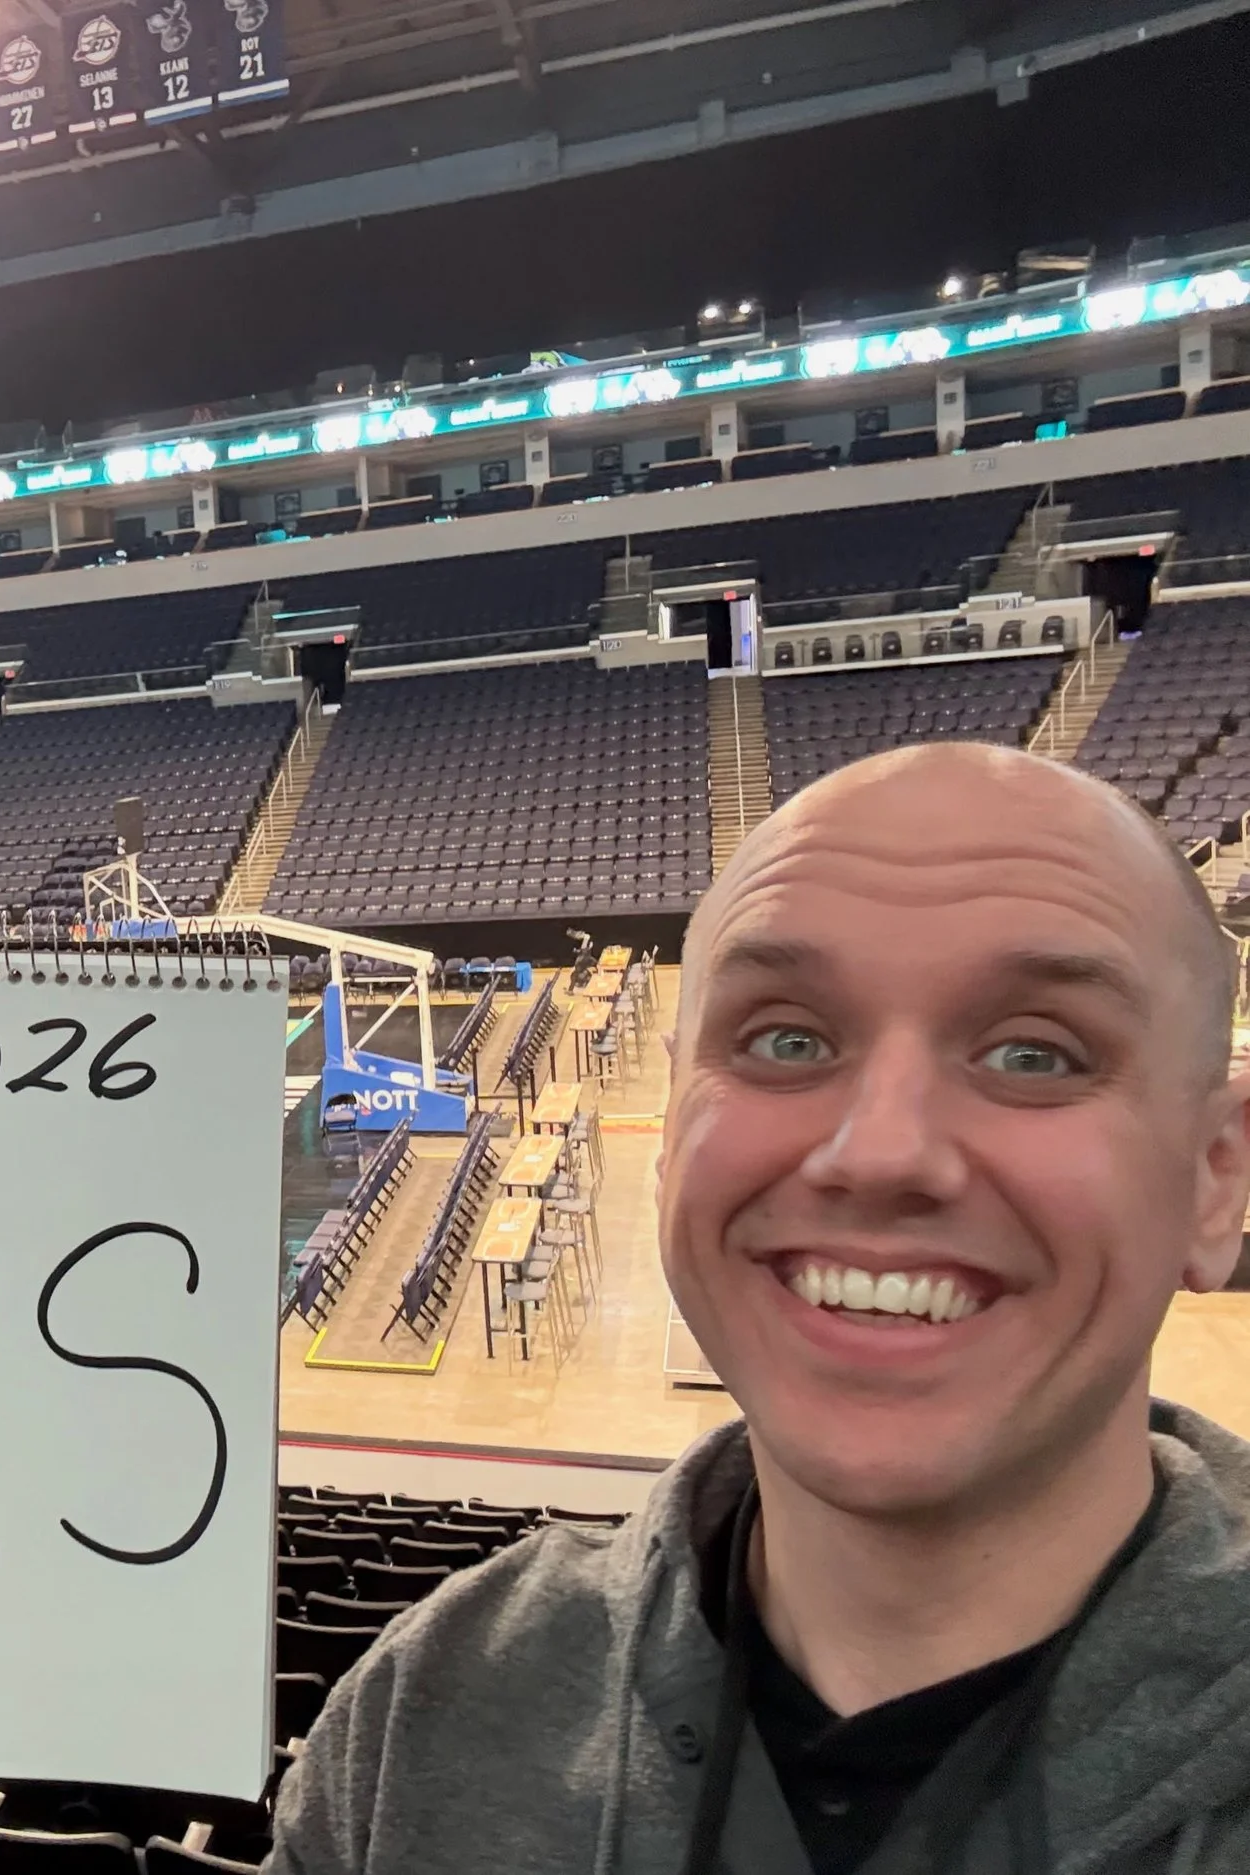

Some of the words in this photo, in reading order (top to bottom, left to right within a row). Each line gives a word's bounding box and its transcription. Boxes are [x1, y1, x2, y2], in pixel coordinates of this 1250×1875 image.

[239, 52, 265, 80] 21
[91, 86, 114, 111] 13
[163, 75, 190, 102] 12
[10, 104, 33, 131] 27
